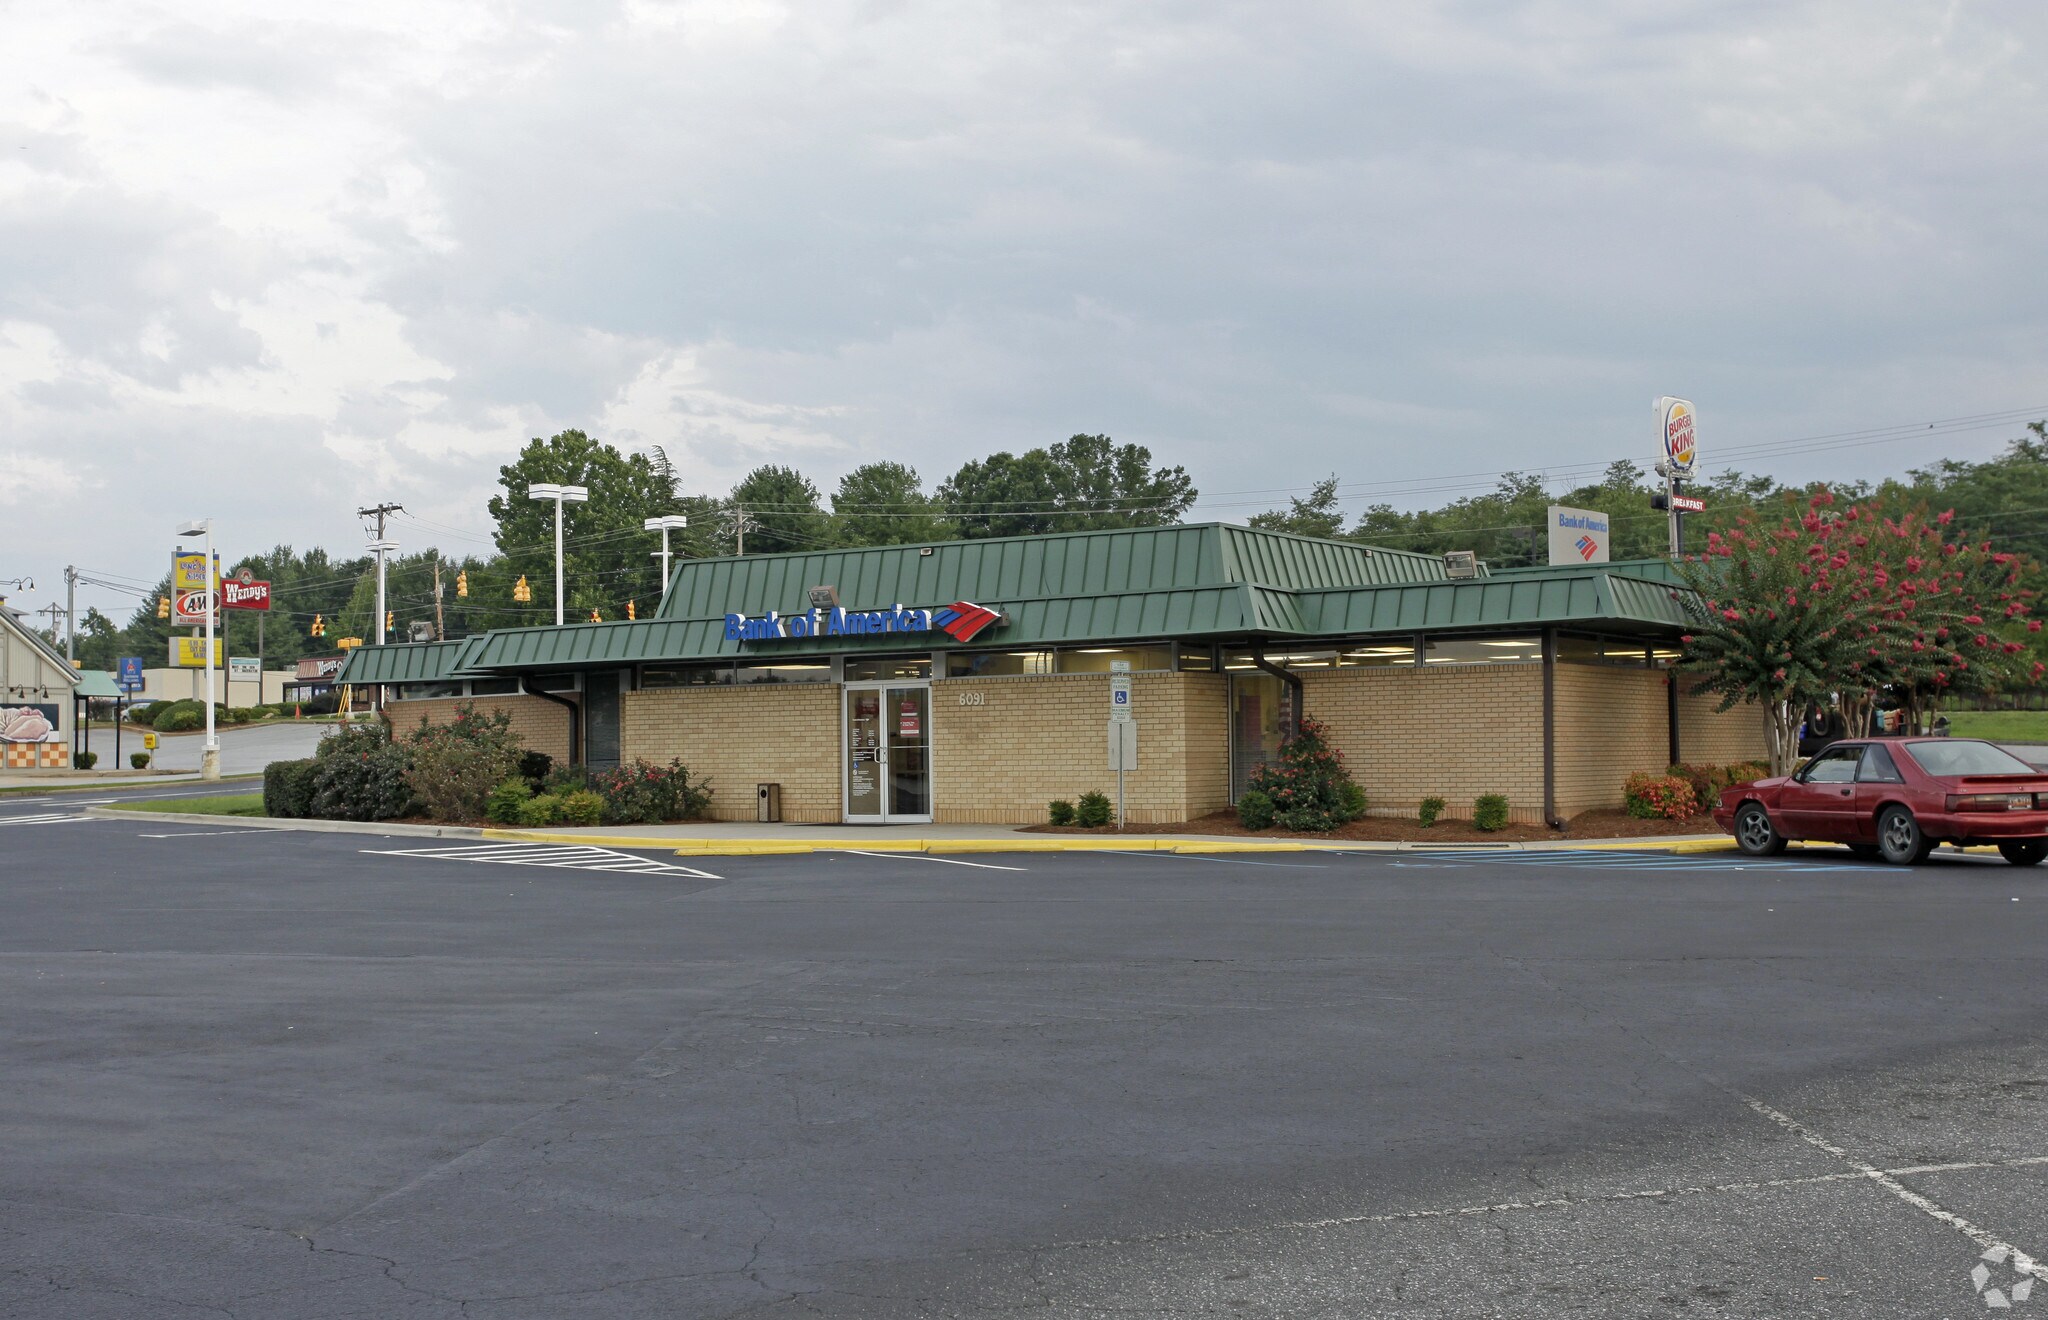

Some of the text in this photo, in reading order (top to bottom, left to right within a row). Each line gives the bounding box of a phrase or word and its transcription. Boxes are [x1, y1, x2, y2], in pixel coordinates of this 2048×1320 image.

[1668, 414, 1692, 437] BURGER
[1671, 428, 1695, 457] KING
[1559, 513, 1578, 529] Bank
[1586, 517, 1608, 533] America
[725, 603, 933, 641] Bank of America
[959, 692, 986, 706] 6091
